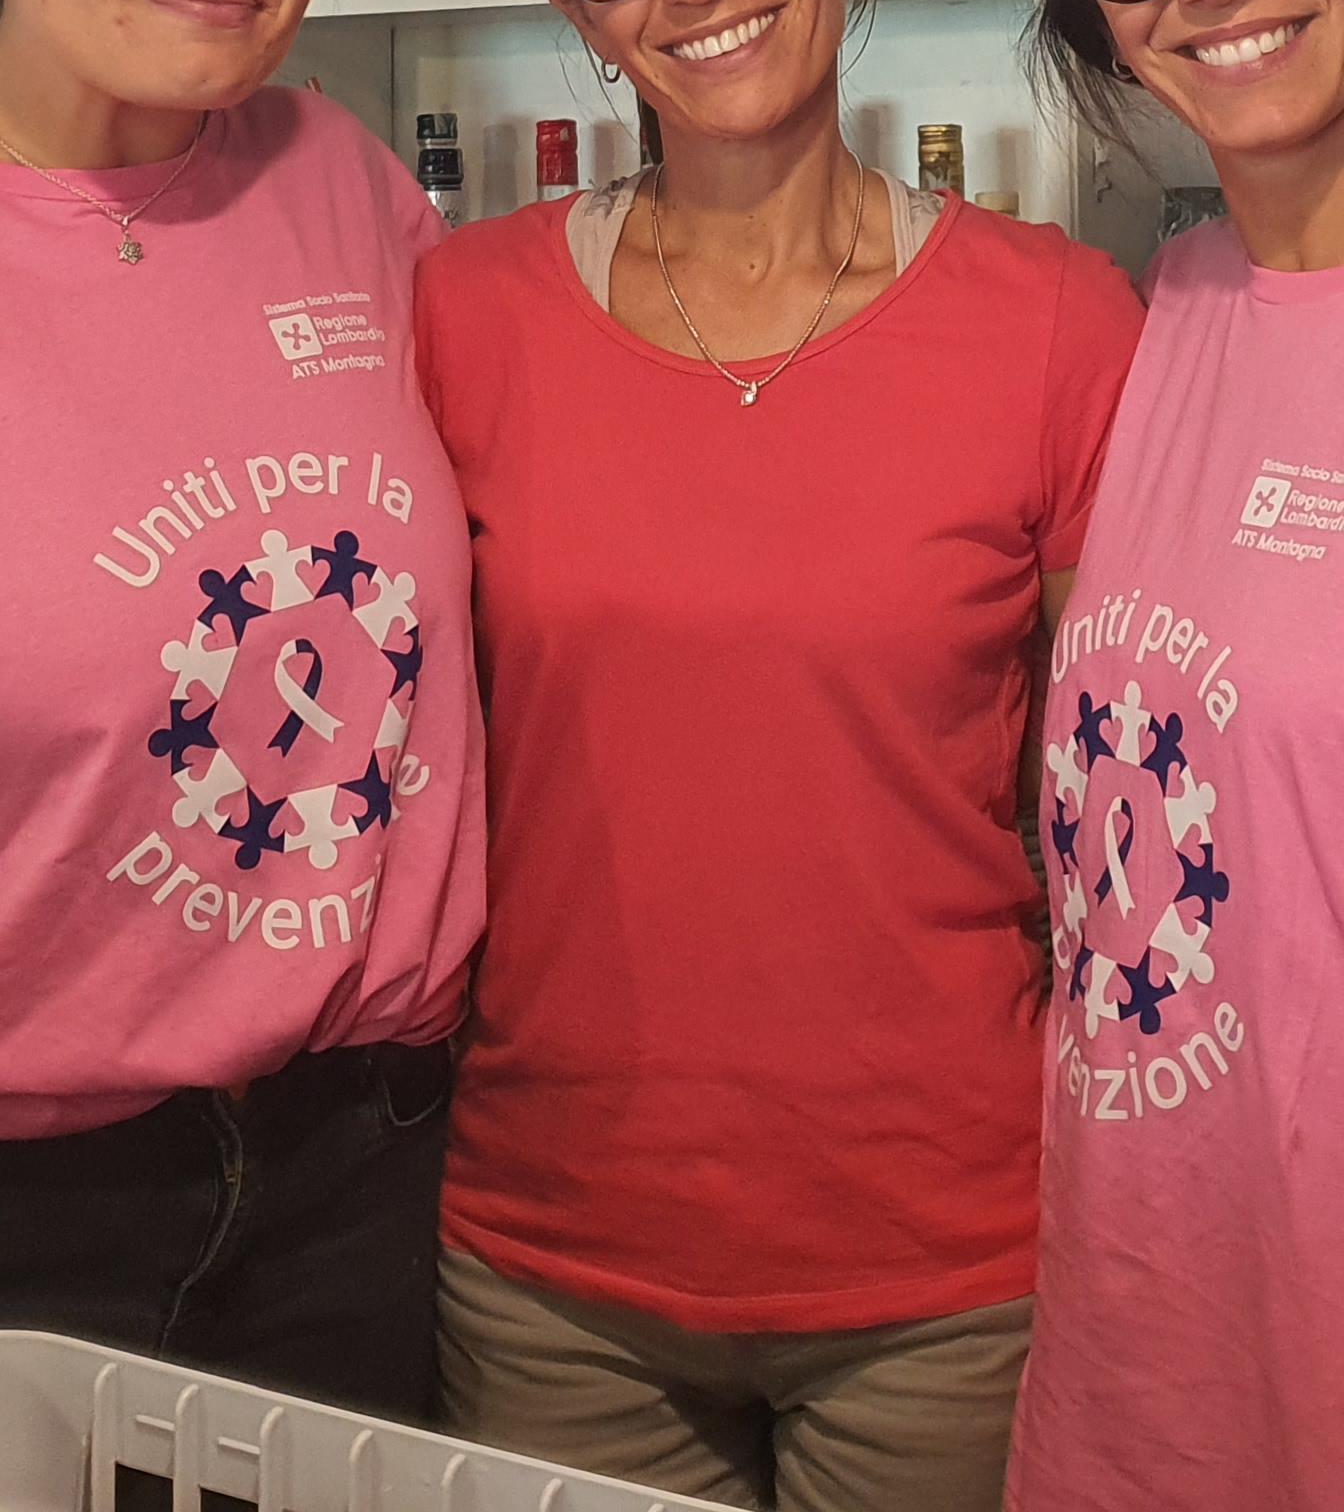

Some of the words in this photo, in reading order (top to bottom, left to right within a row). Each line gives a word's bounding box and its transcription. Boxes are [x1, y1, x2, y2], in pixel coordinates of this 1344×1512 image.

[313, 314, 367, 331] Regione
[320, 327, 385, 345] Lombardia
[292, 360, 320, 379] ATS
[321, 354, 386, 372] Montagna
[93, 457, 237, 588] Uniti
[245, 451, 349, 514] per
[367, 451, 414, 525] la
[1231, 528, 1257, 548] ATS
[1256, 532, 1327, 561] Montagna
[1051, 588, 1142, 683] Uniti
[1135, 603, 1209, 674] per
[1197, 645, 1239, 734] la
